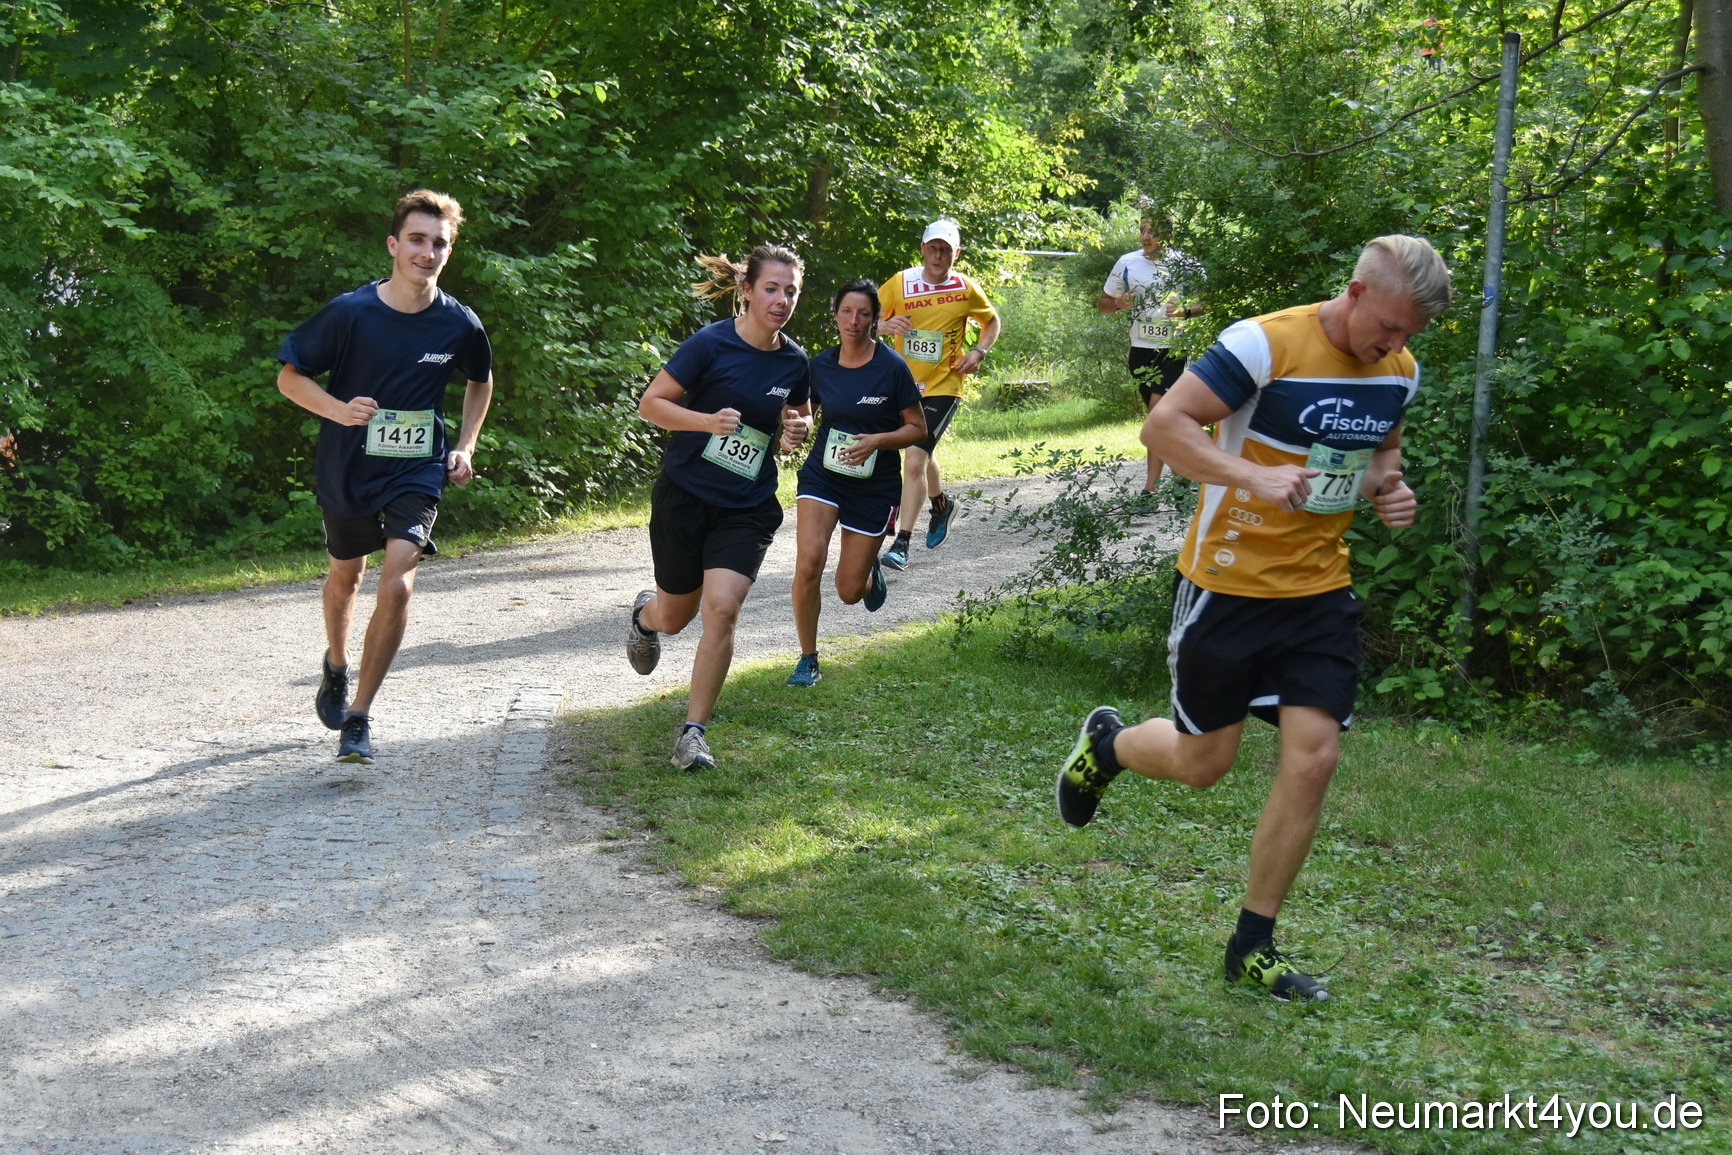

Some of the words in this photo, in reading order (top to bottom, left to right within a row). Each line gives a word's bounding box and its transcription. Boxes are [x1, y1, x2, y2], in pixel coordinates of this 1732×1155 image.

[904, 299, 932, 310] MAX
[937, 293, 968, 305] BÖGL
[1142, 325, 1168, 336] 1838
[907, 339, 936, 353] 1683
[1319, 413, 1394, 433] Fischer
[377, 426, 426, 444] 1412
[719, 435, 760, 465] 1397
[1321, 472, 1355, 495] 778
